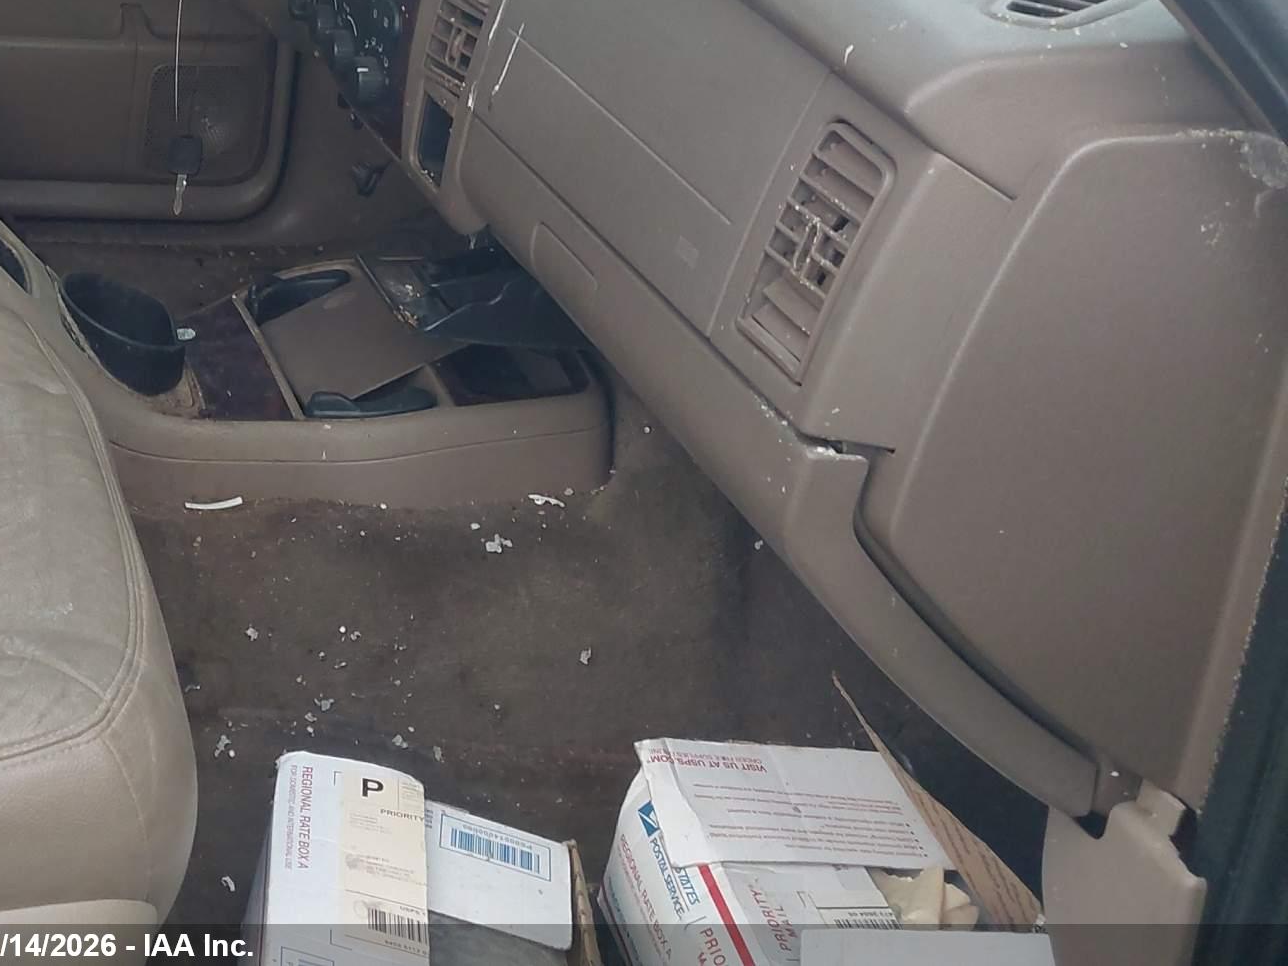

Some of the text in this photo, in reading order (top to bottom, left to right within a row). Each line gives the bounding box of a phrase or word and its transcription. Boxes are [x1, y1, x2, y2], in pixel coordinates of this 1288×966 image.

[708, 759, 721, 769] AT
[723, 761, 739, 770] US
[741, 762, 767, 773] VISIT
[362, 778, 383, 797] P
[297, 766, 313, 869] REGIONAL RATE BOX A
[380, 809, 424, 822] PRIORITY
[649, 837, 669, 874] POSTAL
[621, 834, 642, 892] REGIONAL
[638, 890, 657, 921] RATE
[750, 889, 792, 952] PRIORITY
[774, 906, 798, 938] MAIL
[700, 927, 726, 966] PRIO
